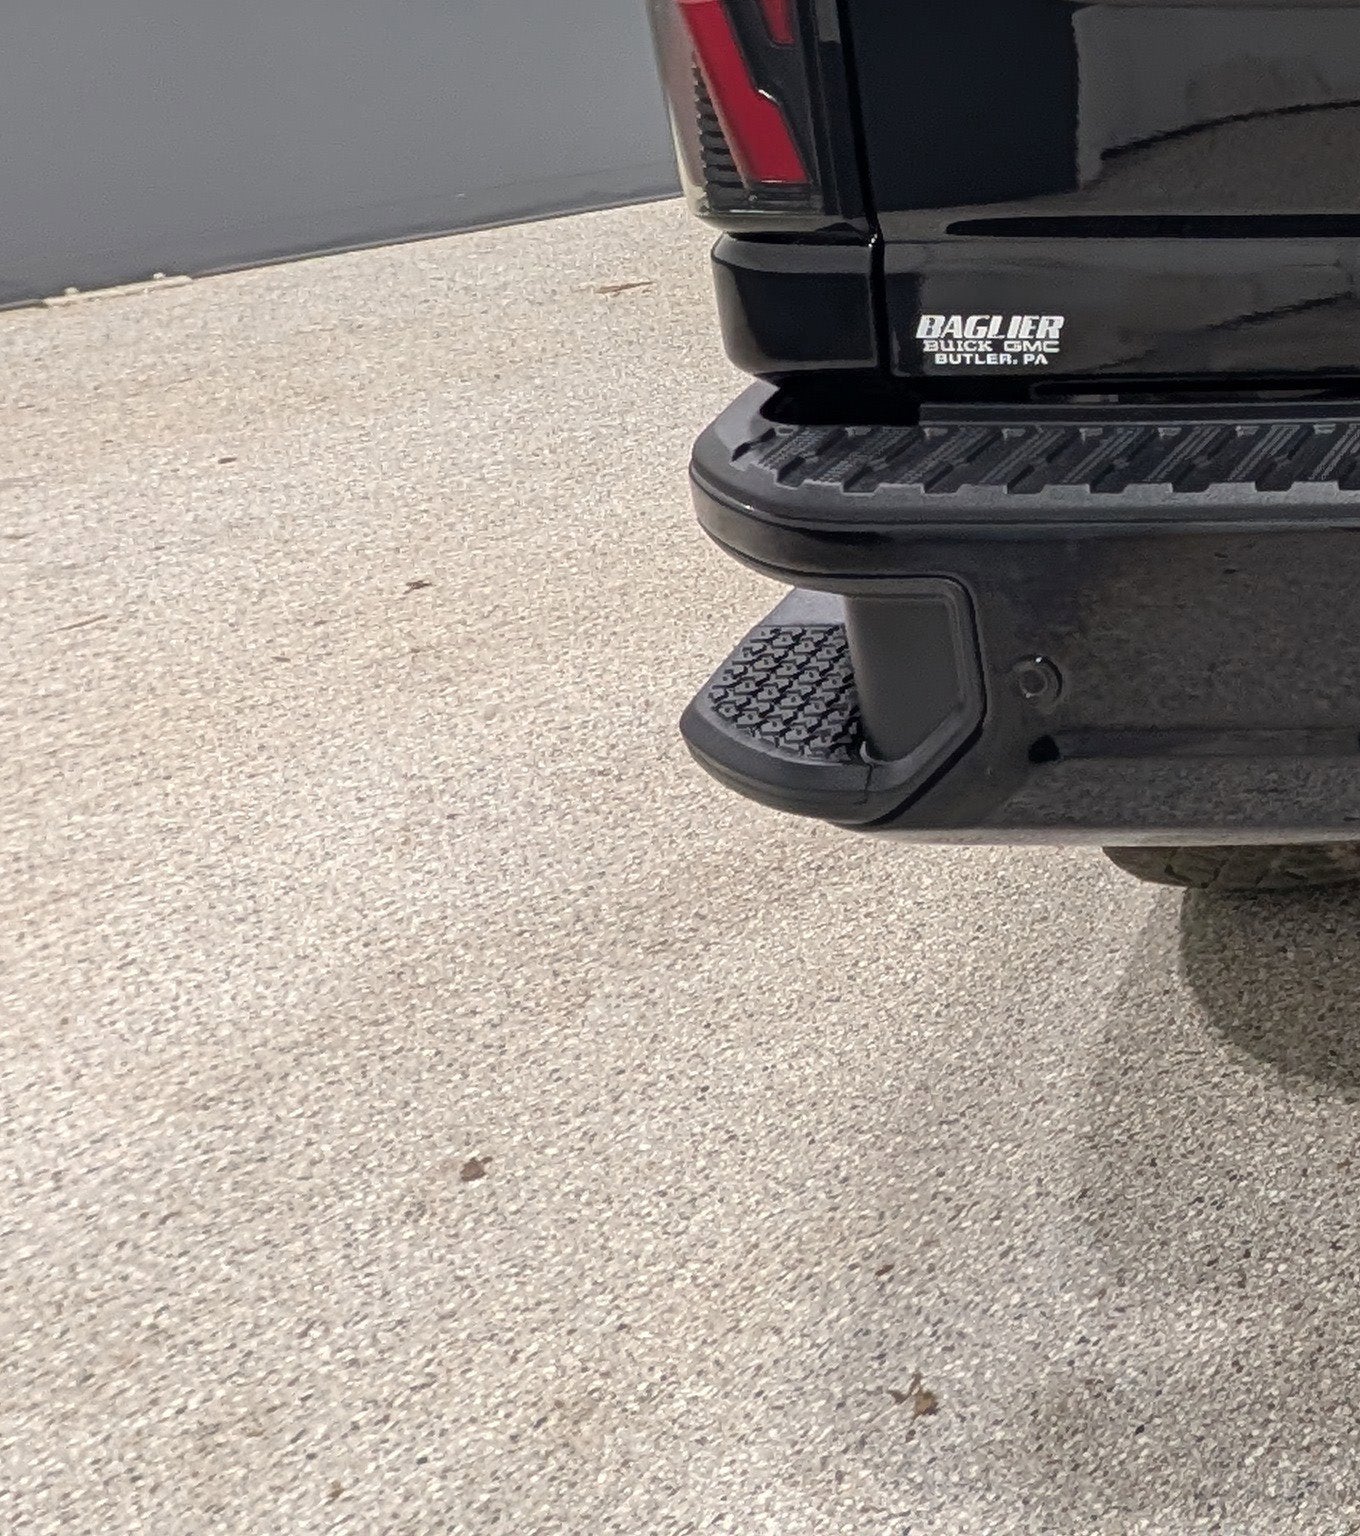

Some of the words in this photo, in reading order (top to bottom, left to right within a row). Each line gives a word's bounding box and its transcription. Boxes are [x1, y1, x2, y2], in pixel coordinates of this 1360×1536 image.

[916, 315, 1065, 338] BAGLIER
[923, 340, 993, 352] BUICK
[1004, 340, 1060, 352] GMC
[1023, 354, 1049, 365] PA
